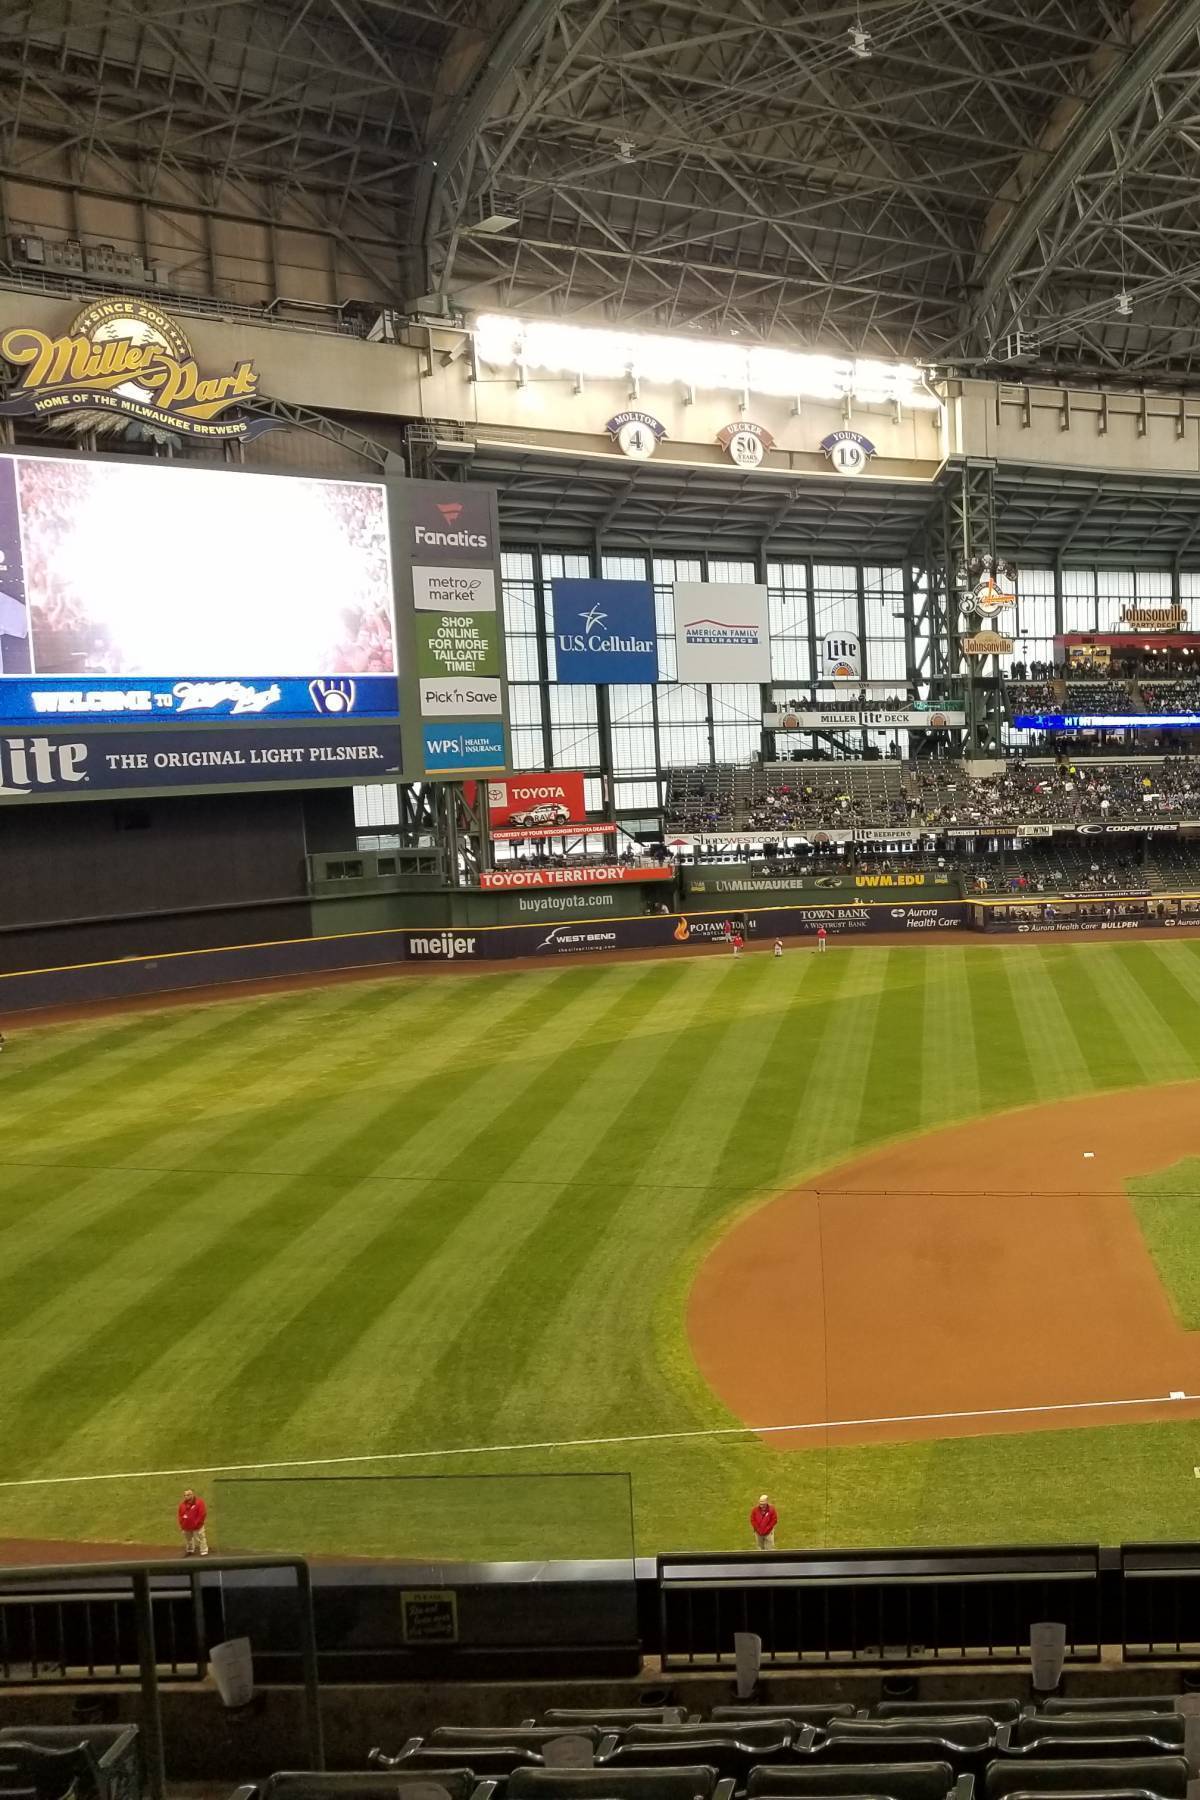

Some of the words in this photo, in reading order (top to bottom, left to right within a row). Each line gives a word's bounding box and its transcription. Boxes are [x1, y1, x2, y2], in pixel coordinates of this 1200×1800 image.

[89, 303, 134, 322] SINCE
[138, 308, 171, 330] 2001
[3, 329, 164, 388] Miller
[137, 355, 258, 409] Park
[35, 394, 70, 411] HOME
[72, 394, 89, 403] OF
[93, 394, 118, 407] THE
[121, 396, 190, 431] MILWAUKEE
[193, 422, 247, 435] BREWERS
[614, 412, 658, 428] MOLITOR
[727, 423, 762, 435] UECKER
[628, 430, 643, 451] 4
[832, 432, 864, 443] YOUNT
[737, 437, 756, 453] 50
[839, 448, 860, 467] 19
[415, 526, 488, 548] Fanatics
[428, 577, 467, 588] metro
[429, 589, 475, 601] market
[1119, 604, 1188, 622] Johnsonville
[442, 617, 473, 628] SHOP
[437, 628, 479, 638] ONLINE
[428, 638, 452, 649] FOR
[455, 639, 488, 650] MORE
[559, 635, 586, 652] U.S.
[588, 636, 653, 652] Cellular
[965, 640, 1011, 653] Johnsonville
[433, 650, 485, 660] TAILGATE
[827, 640, 857, 660] Lite
[445, 661, 476, 672] TIME!
[466, 691, 497, 702] Save
[821, 715, 856, 723] MILLER
[884, 714, 909, 722] DECK
[427, 739, 460, 754] WPS
[465, 745, 502, 753] INSURANCE
[105, 754, 149, 770] THE
[154, 750, 245, 769] ORIGINAL
[250, 748, 304, 764] LIGHT
[309, 746, 384, 762] PILSNER.
[512, 787, 565, 800] TOYOTA
[483, 872, 542, 886] TOYOTA
[546, 867, 625, 882] TERRITORY
[855, 875, 924, 887] UWM.EDU
[519, 895, 613, 912] buyatoyota.com
[800, 910, 835, 920] TOWN
[838, 908, 871, 919] BANK
[907, 908, 938, 917] Aurora
[848, 920, 867, 928] BANK
[907, 918, 936, 928] Health
[938, 918, 958, 926] Care
[1101, 921, 1139, 929] BULLPEN
[556, 935, 586, 943] WEST
[410, 932, 476, 959] meijer
